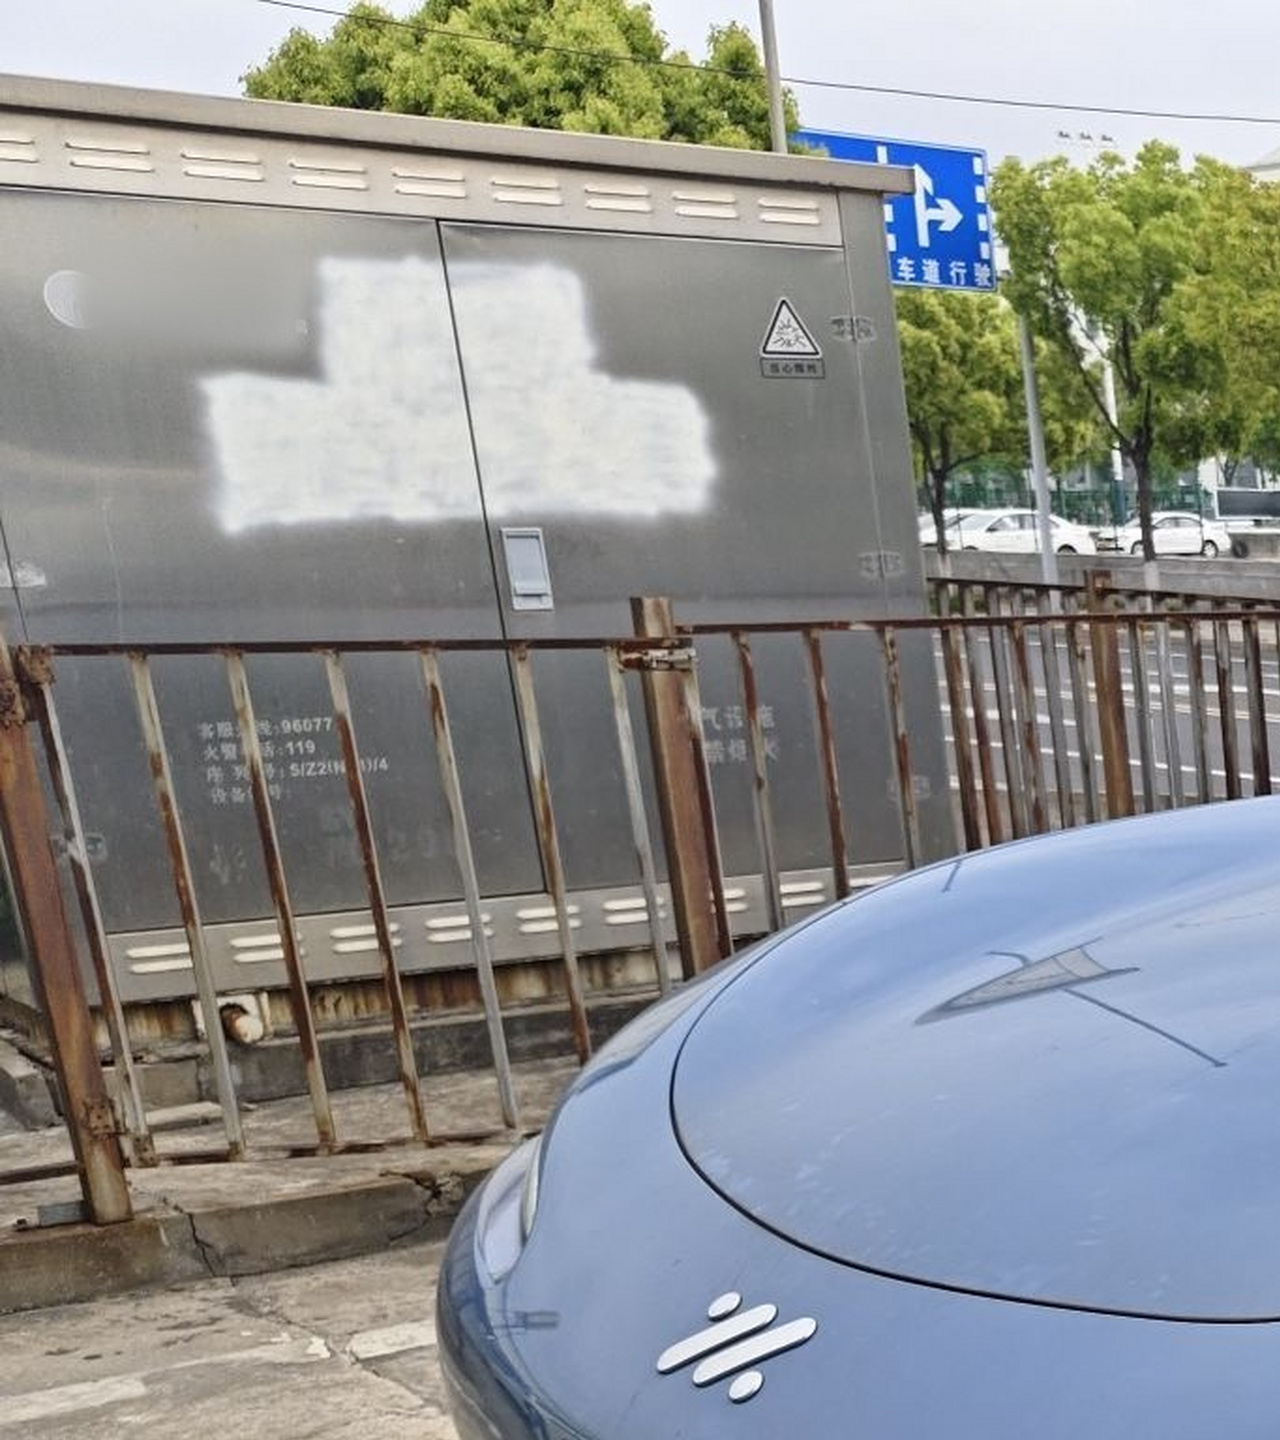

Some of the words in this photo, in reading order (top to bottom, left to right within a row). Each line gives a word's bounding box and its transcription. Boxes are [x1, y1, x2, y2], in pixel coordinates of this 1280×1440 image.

[897, 256, 992, 287] 车道行驶
[198, 716, 334, 739] 客服线:96077
